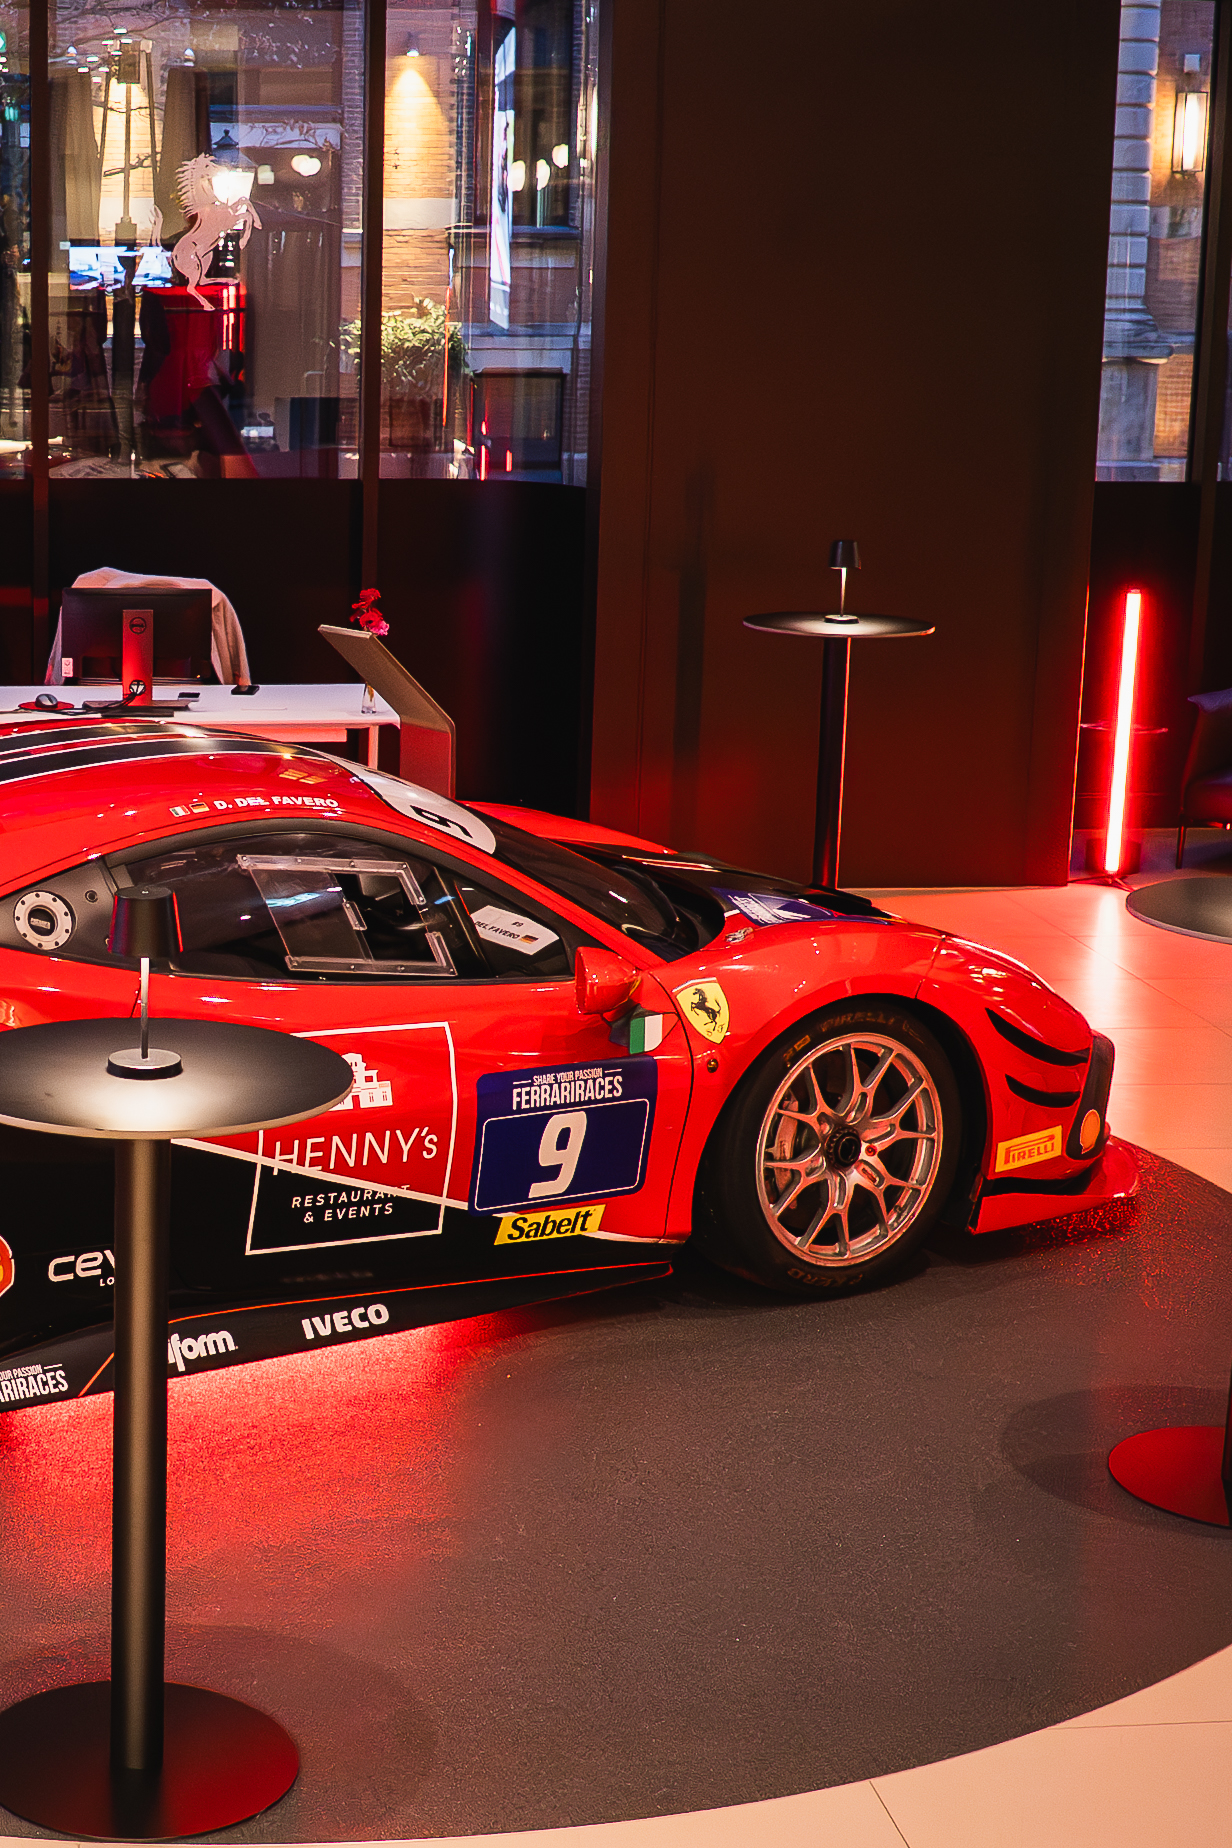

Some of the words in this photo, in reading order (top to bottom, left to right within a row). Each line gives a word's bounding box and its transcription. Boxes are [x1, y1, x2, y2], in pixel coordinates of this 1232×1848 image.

[214, 800, 233, 810] D.
[234, 797, 270, 807] DEL
[272, 796, 339, 808] FAVERO
[488, 926, 521, 940] FAVERO
[533, 1073, 556, 1086] SHARE
[556, 1071, 574, 1083] YOUR
[574, 1068, 603, 1081] PASSION
[512, 1076, 623, 1110] FERRARIRACES
[528, 1111, 587, 1198] 9
[1004, 1133, 1056, 1165] PIRELLI
[303, 1211, 314, 1224] &
[324, 1203, 394, 1221] EVENTS
[507, 1210, 592, 1240] Sabelt
[301, 1303, 390, 1340] IVECO
[13, 1364, 43, 1378] PASSION
